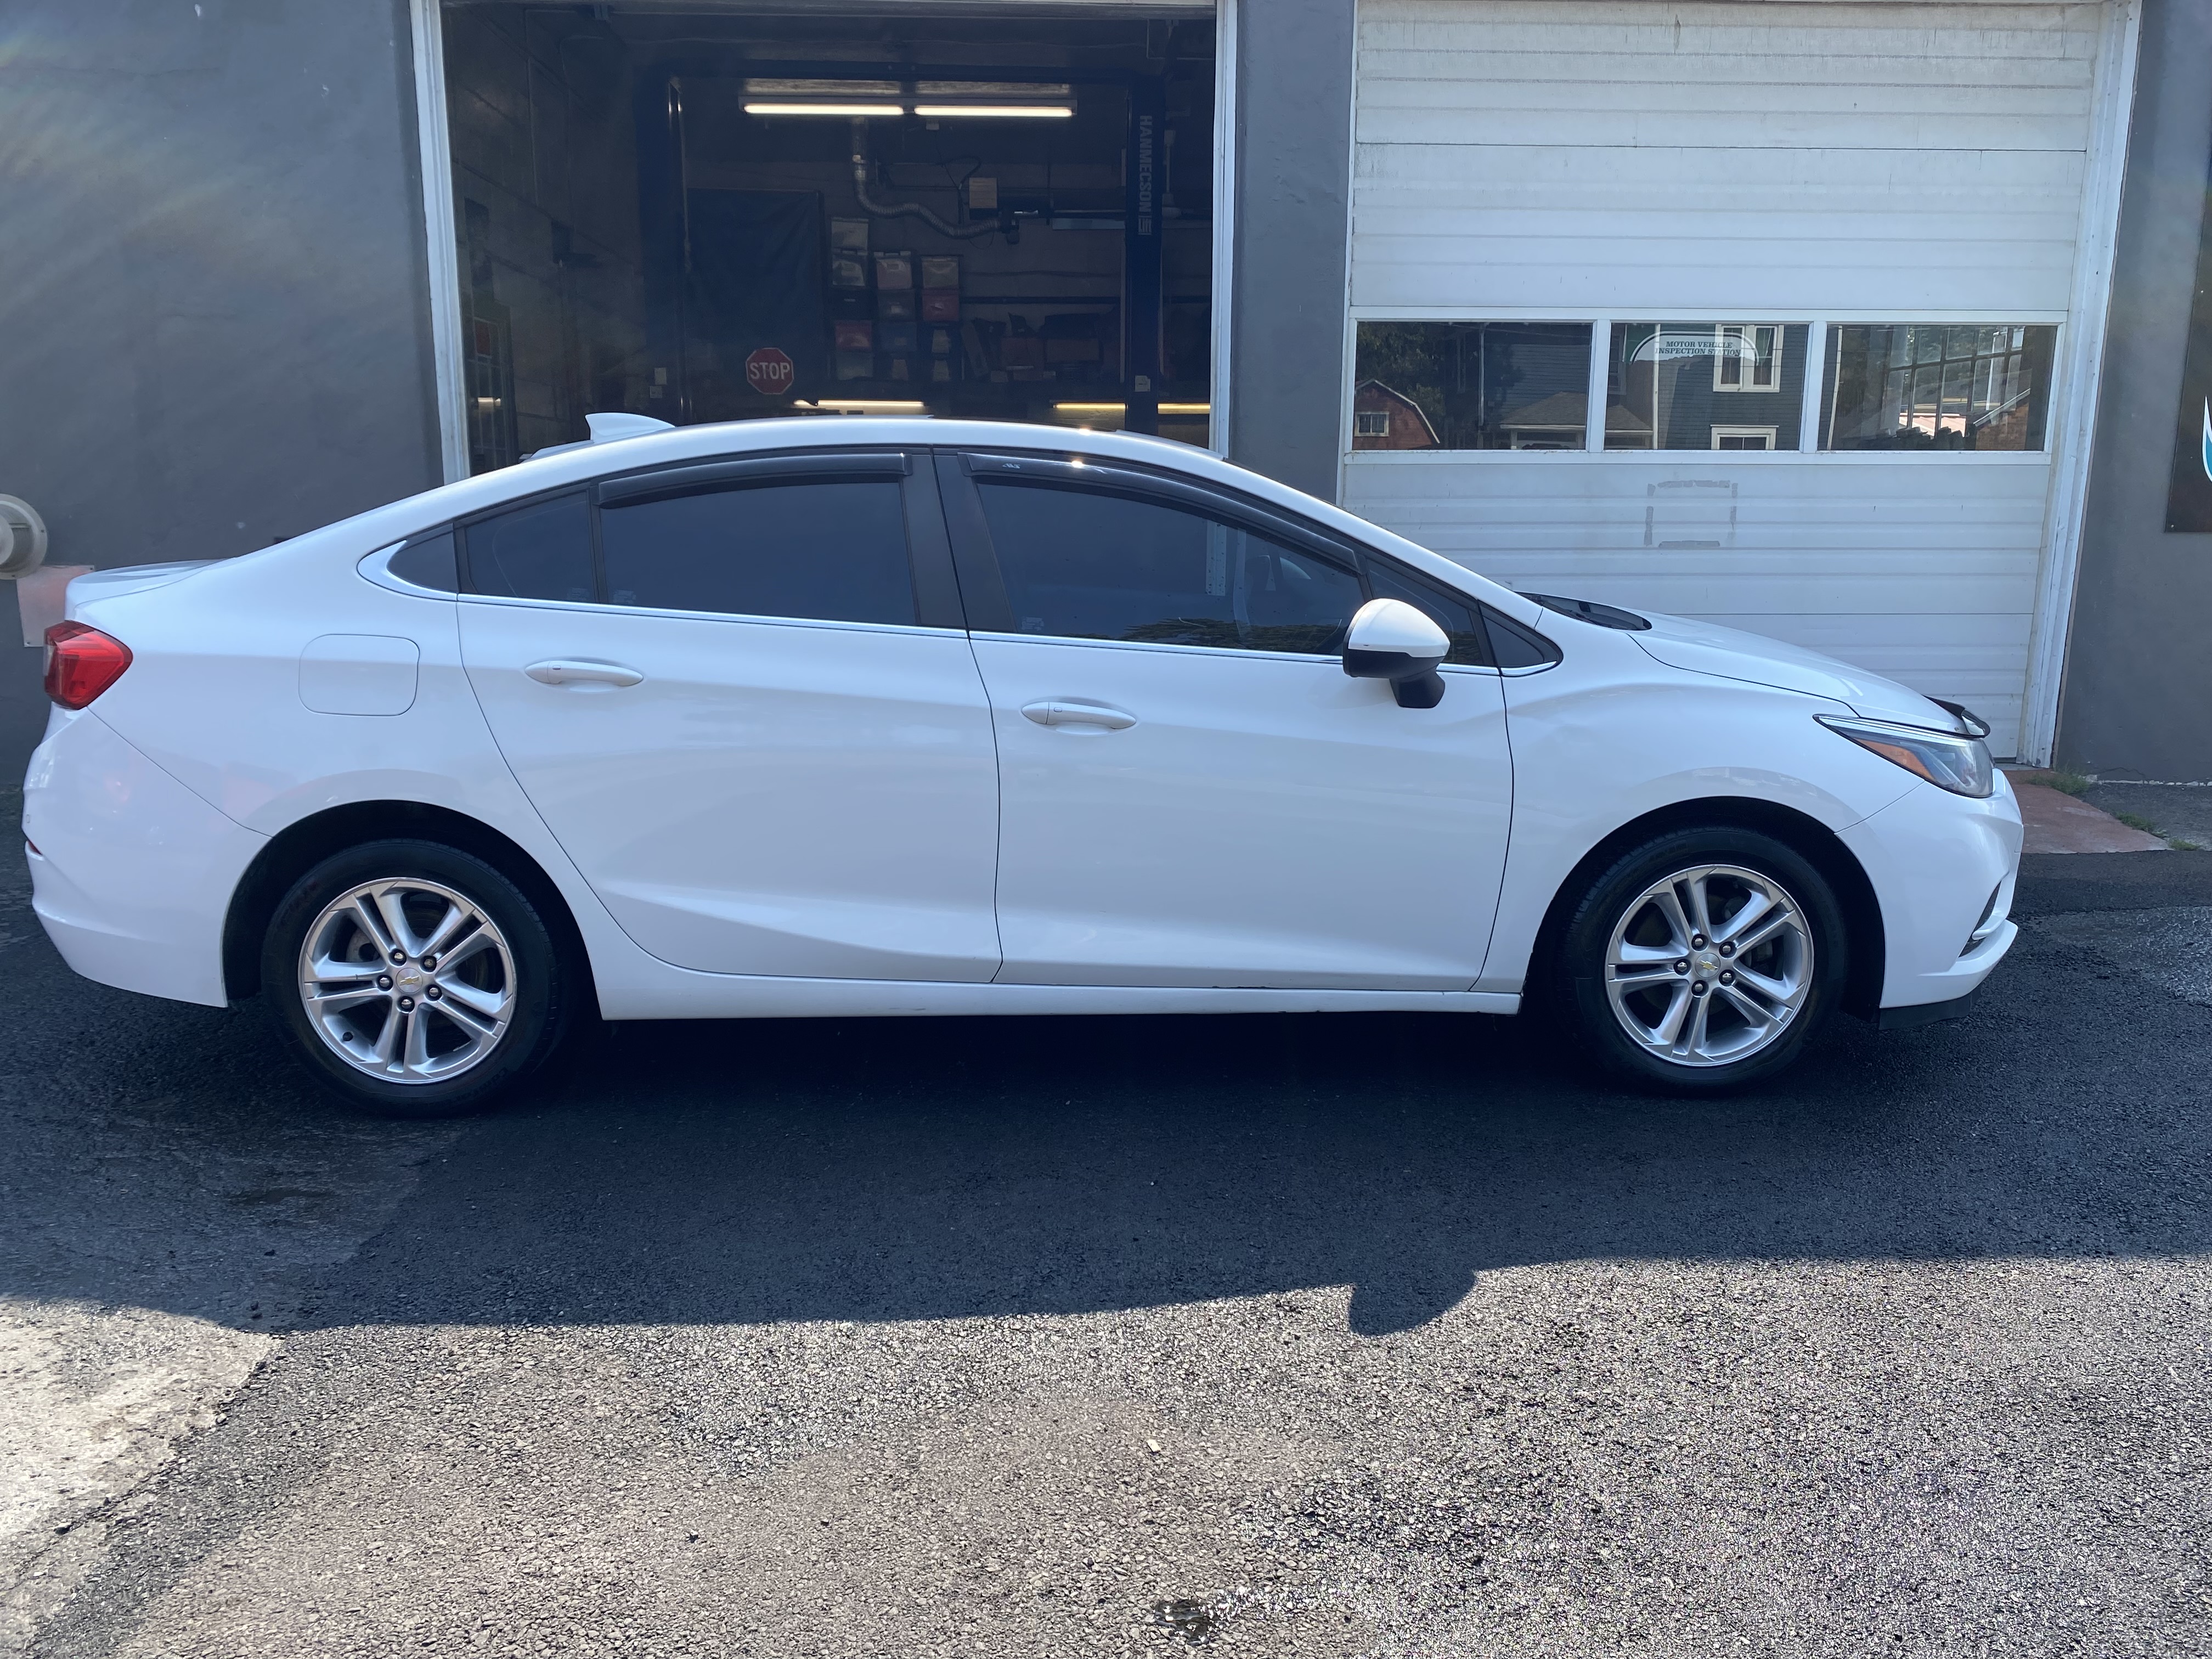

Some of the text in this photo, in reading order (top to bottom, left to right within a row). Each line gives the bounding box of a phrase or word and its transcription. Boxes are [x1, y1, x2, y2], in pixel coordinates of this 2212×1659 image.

[1139, 115, 1152, 212] HANMECSON
[1707, 348, 1741, 357] STATION
[749, 362, 790, 380] STOP
